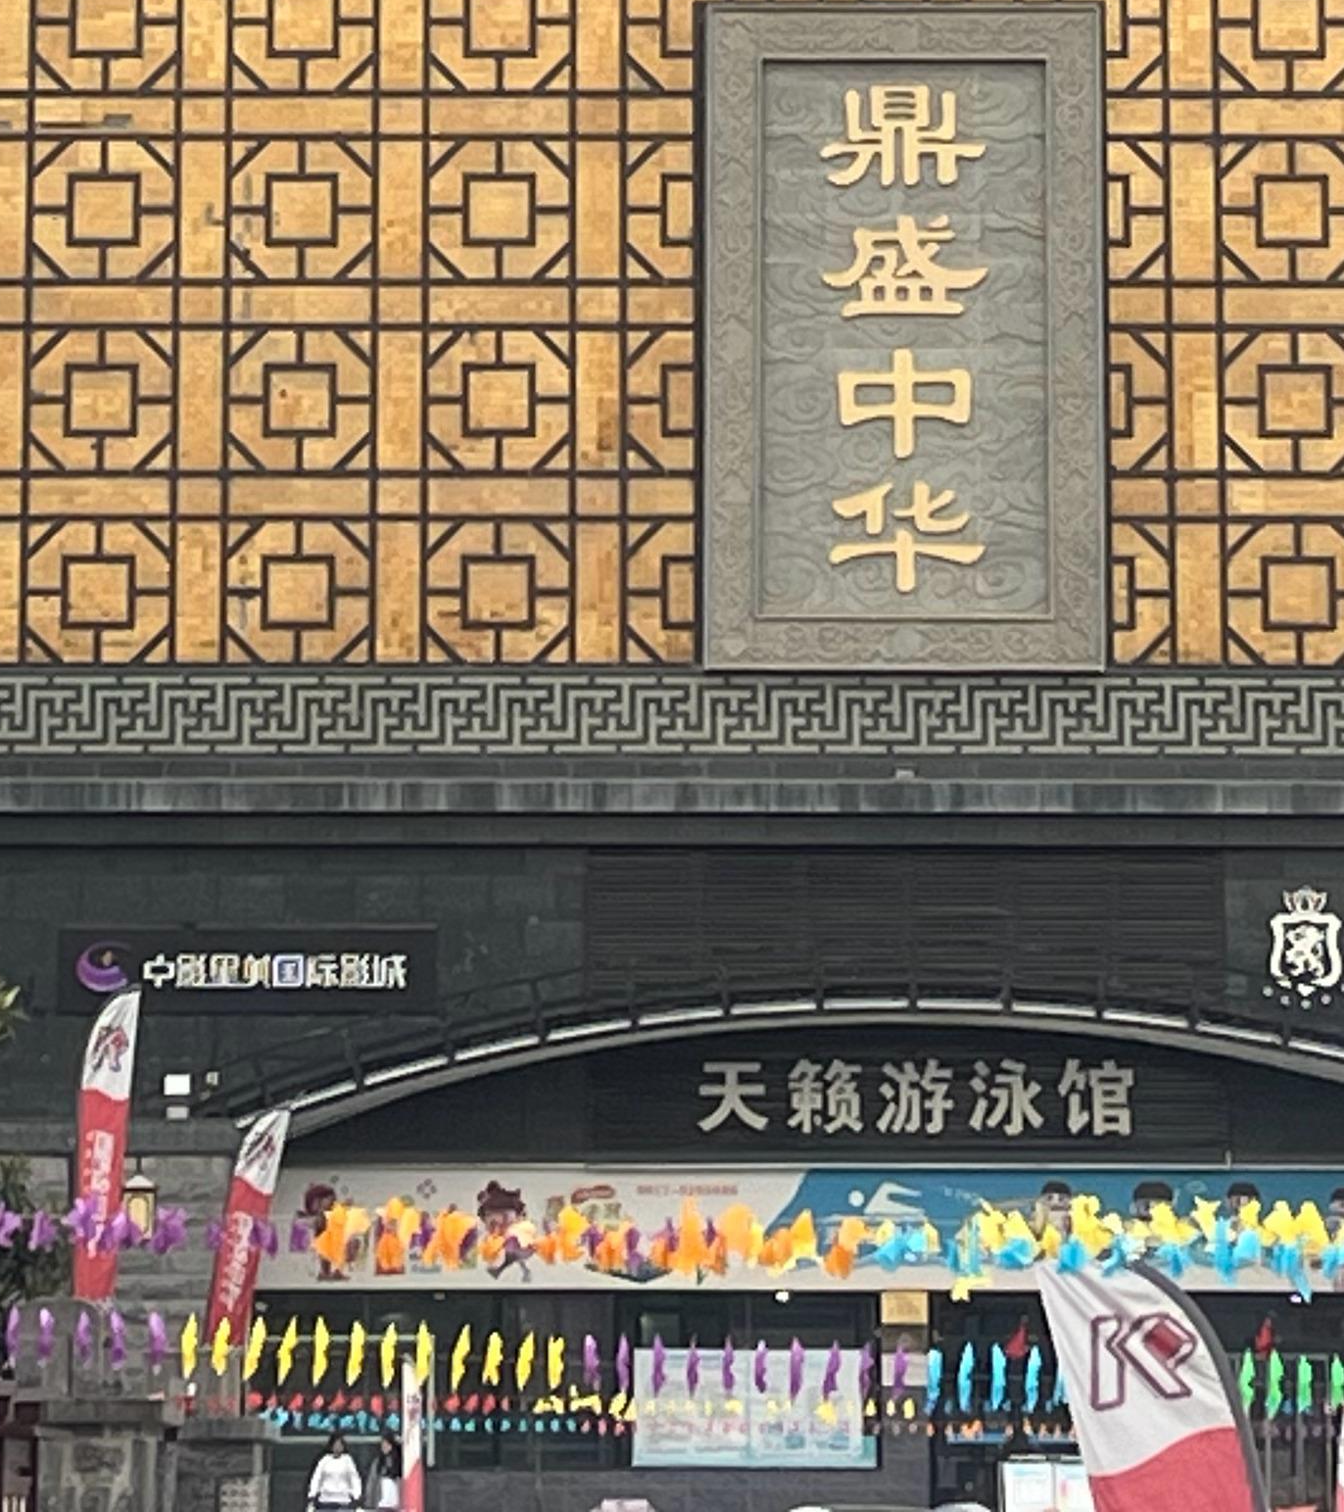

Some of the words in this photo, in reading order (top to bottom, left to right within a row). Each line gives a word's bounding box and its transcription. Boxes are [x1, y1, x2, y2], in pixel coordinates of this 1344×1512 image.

[819, 85, 989, 594] 鼎盛中华
[697, 1059, 1135, 1136] 天籁游泳馆
